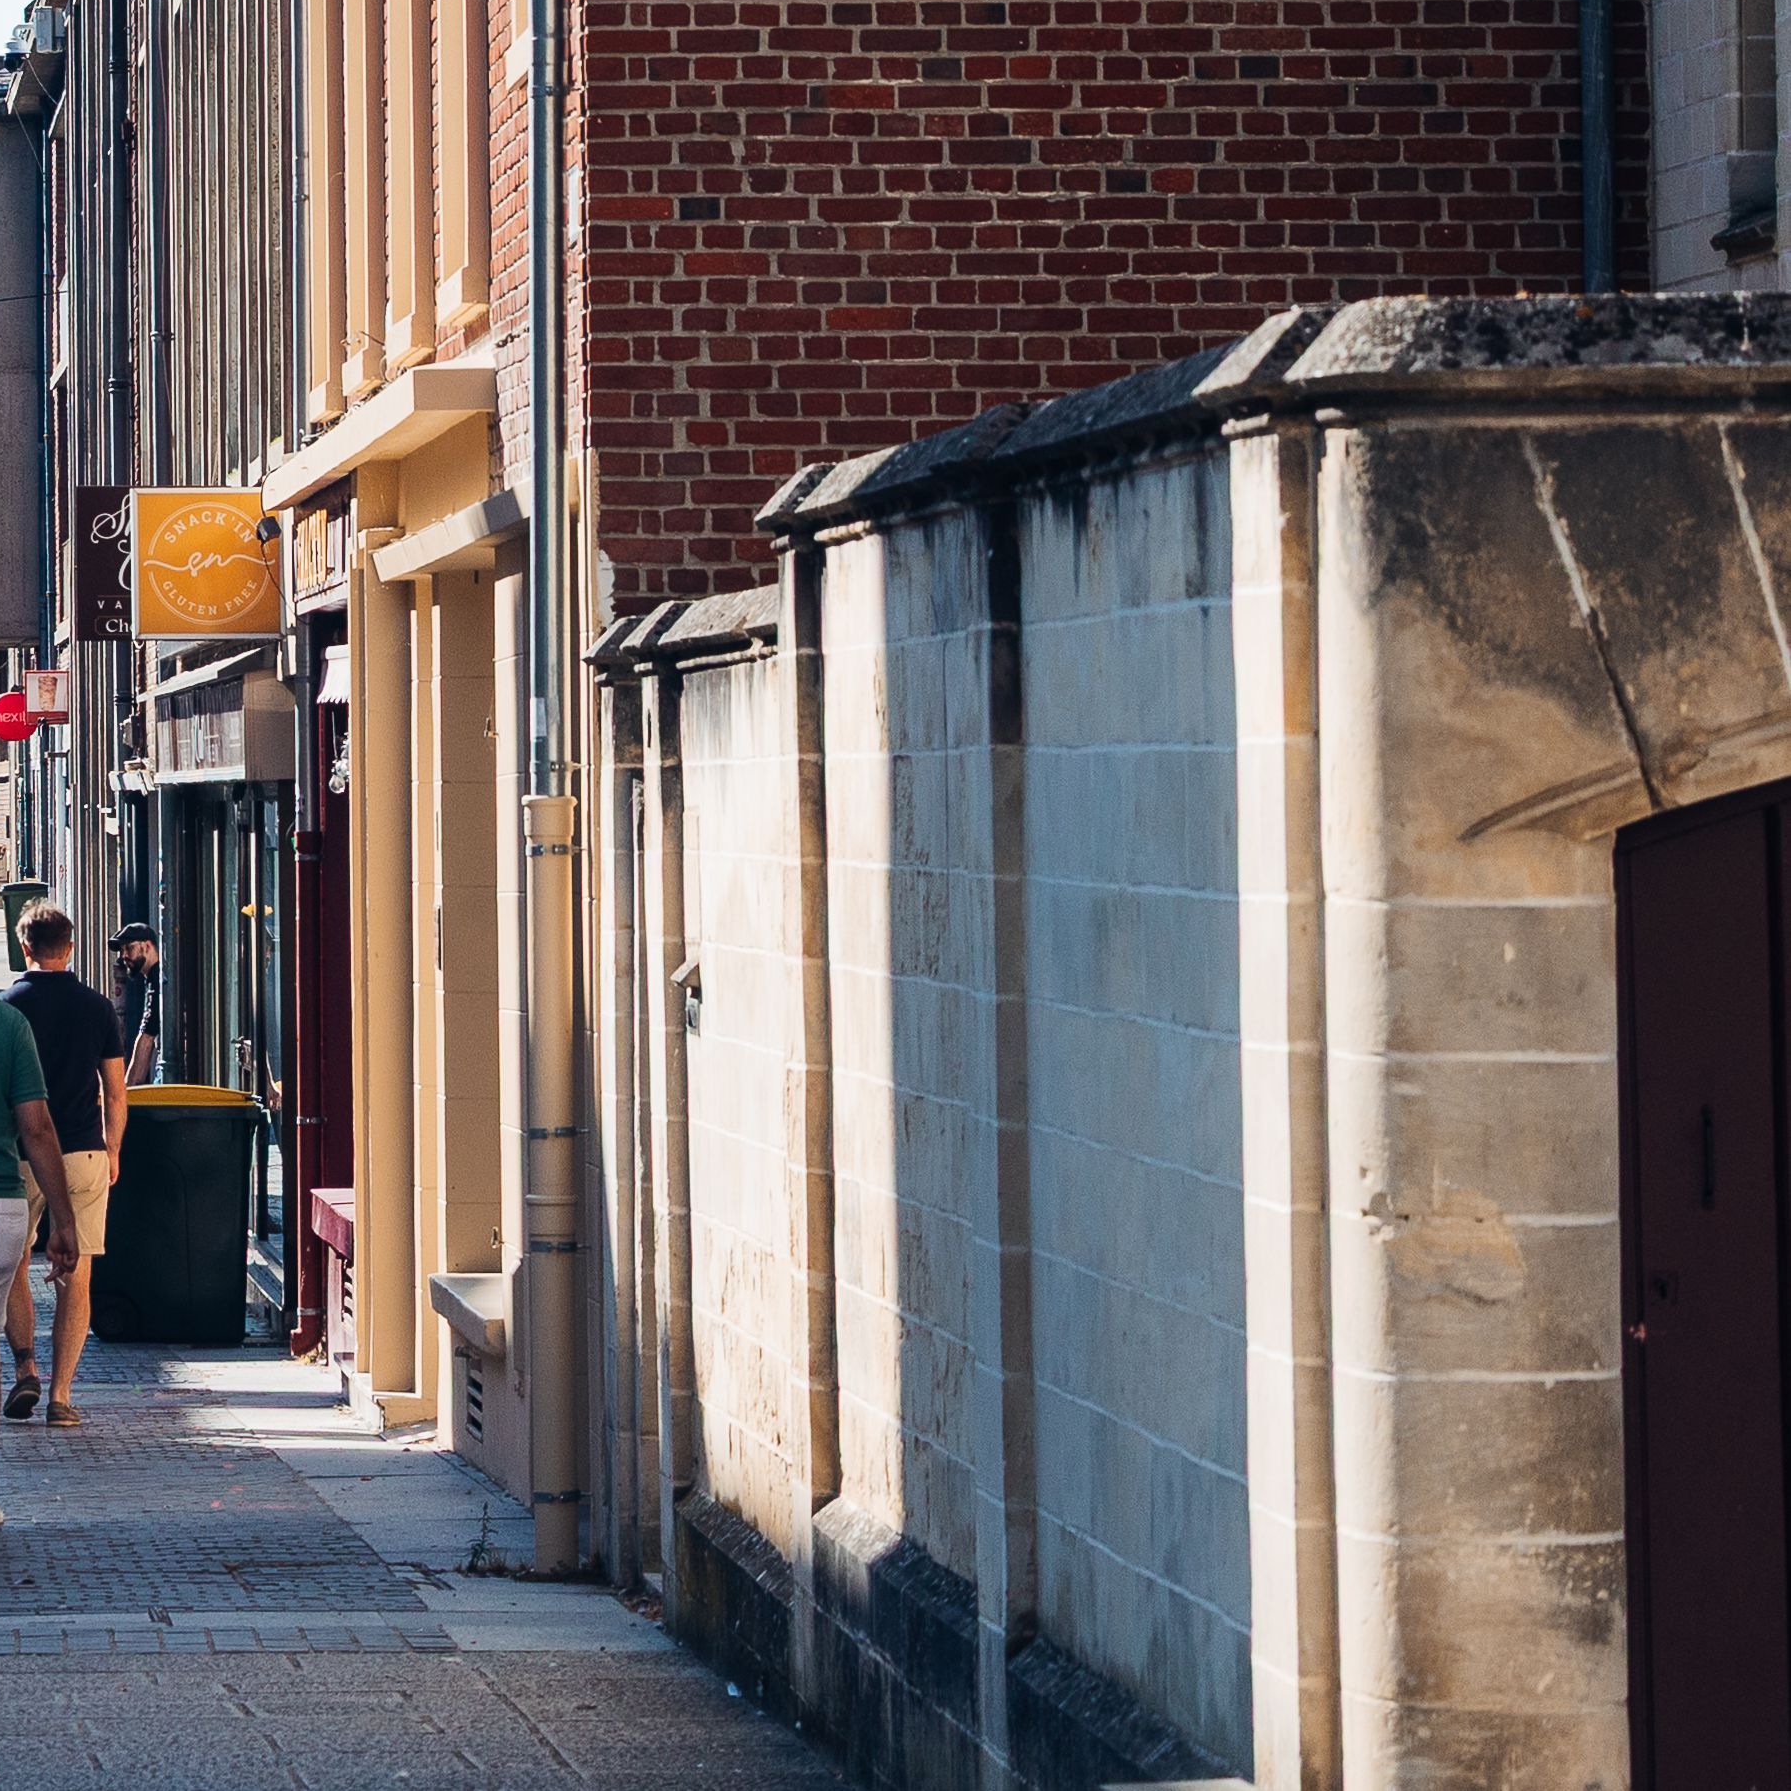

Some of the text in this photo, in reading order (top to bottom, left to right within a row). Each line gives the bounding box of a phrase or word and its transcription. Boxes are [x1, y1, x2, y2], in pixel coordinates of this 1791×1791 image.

[164, 511, 254, 544] SNACK'IN
[162, 580, 257, 615] GLUTEN FREE
